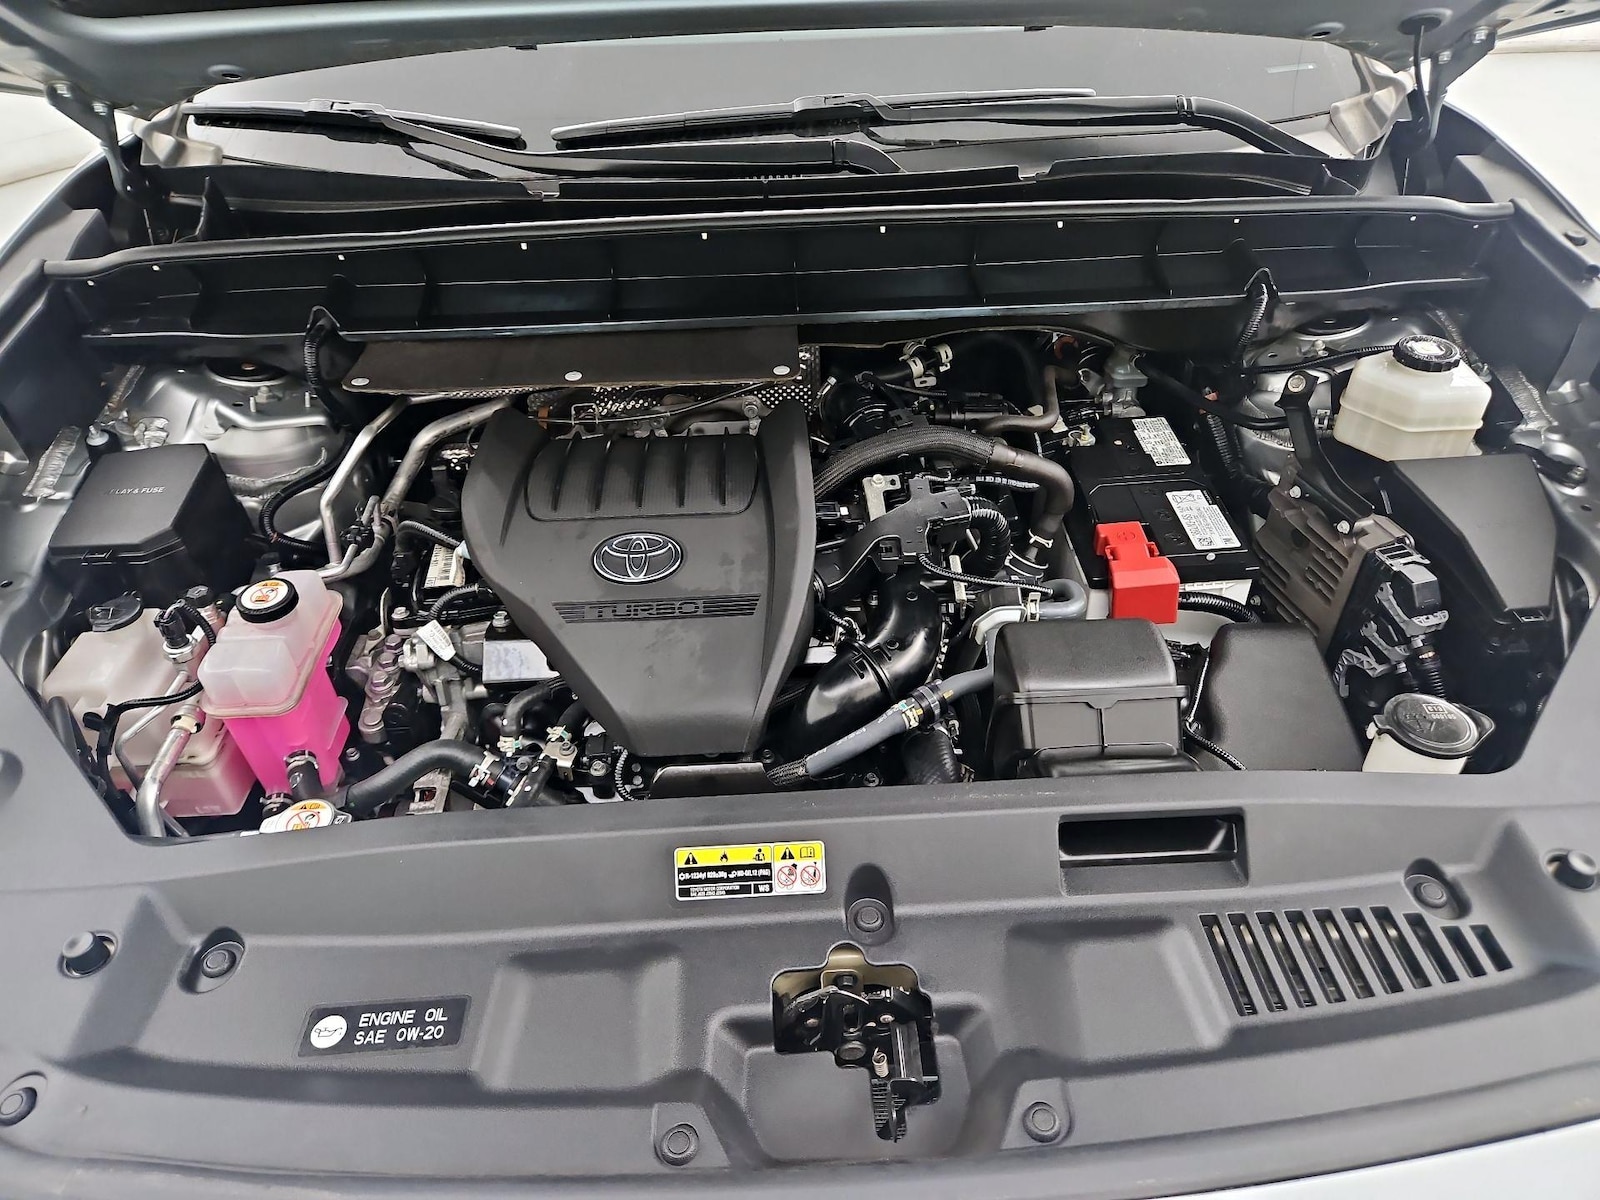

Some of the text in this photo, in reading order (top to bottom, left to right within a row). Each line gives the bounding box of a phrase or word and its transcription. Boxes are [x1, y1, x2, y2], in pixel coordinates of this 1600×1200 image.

[141, 486, 165, 494] FUSE
[589, 601, 700, 618] TURBO
[359, 1008, 448, 1028] ENGINE OIL
[354, 1025, 445, 1045] SAE 0W-20
